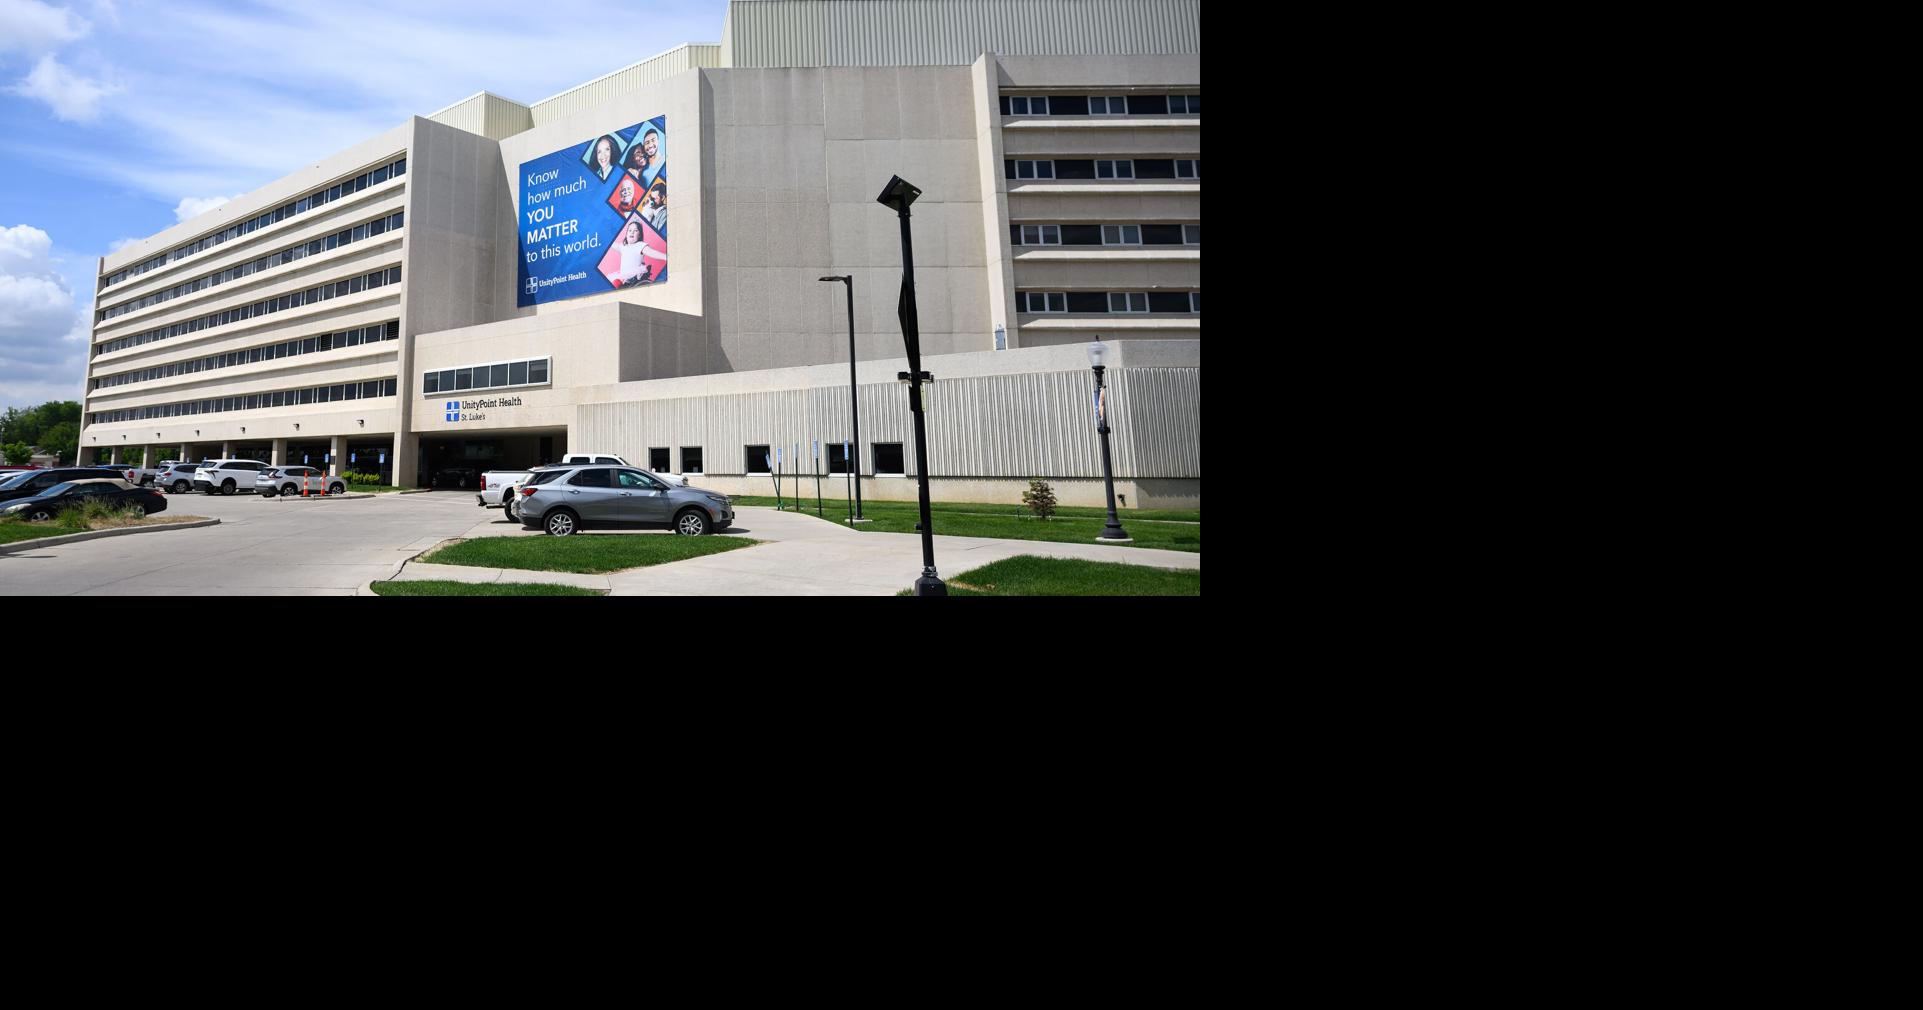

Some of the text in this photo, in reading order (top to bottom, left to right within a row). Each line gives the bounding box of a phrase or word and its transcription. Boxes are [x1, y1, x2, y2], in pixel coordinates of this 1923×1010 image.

[528, 169, 559, 187] Know
[528, 176, 587, 205] how much
[527, 205, 554, 225] YOU
[527, 219, 578, 244] MATTER
[527, 232, 601, 263] to this world.
[539, 271, 587, 287] UnityPoint Health
[462, 396, 522, 410] UnityPoint Health
[469, 412, 486, 421] Luke's
